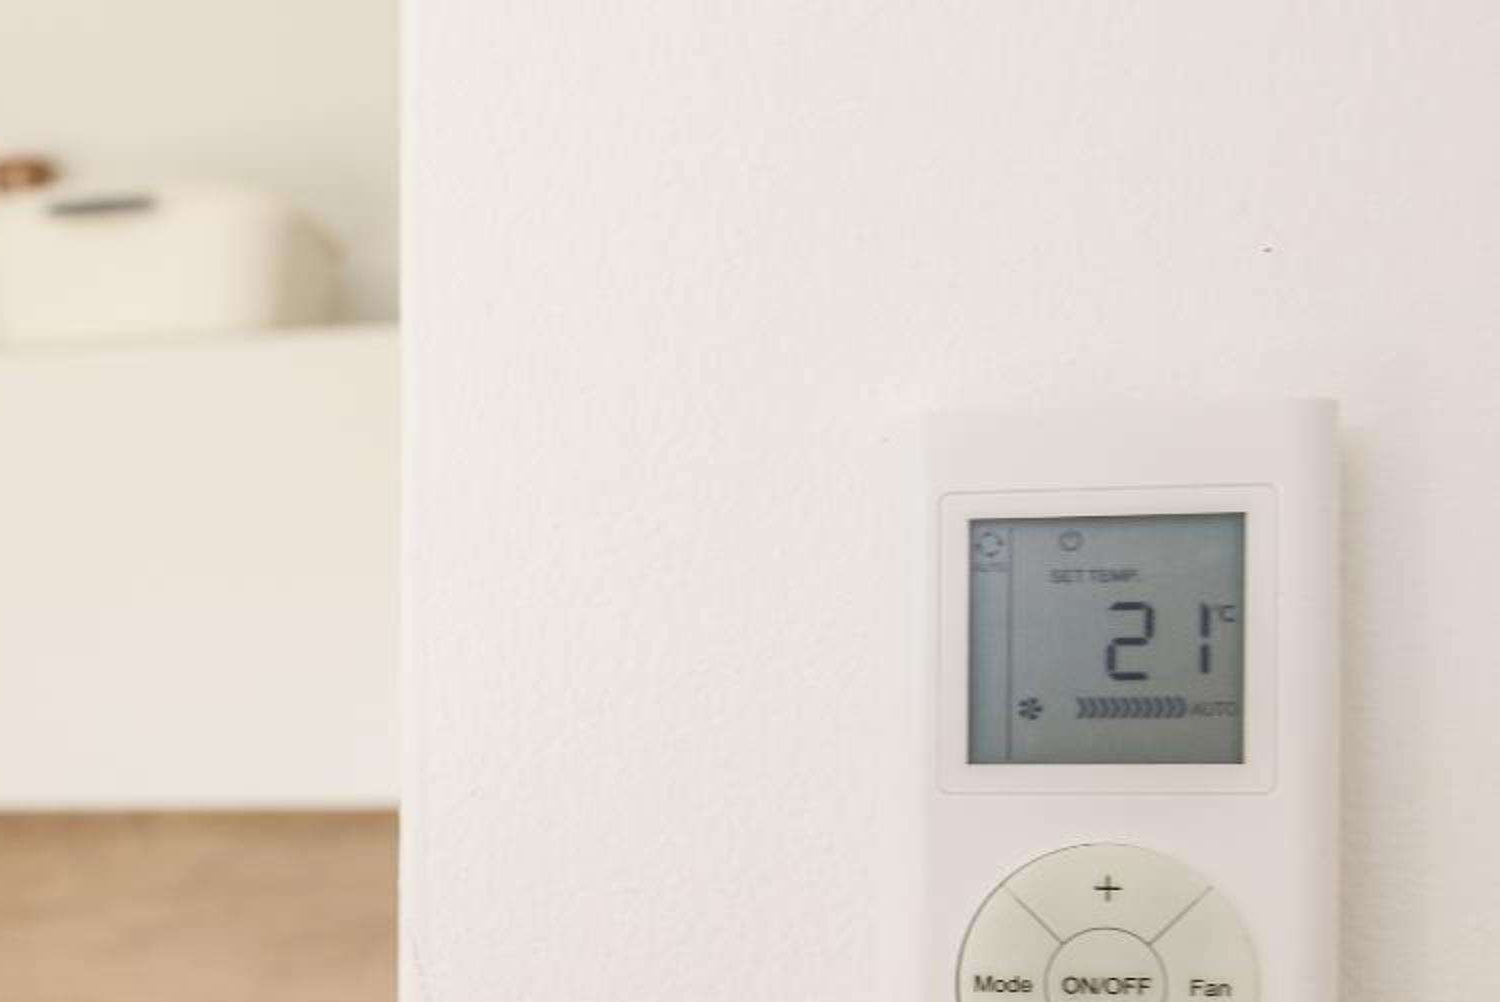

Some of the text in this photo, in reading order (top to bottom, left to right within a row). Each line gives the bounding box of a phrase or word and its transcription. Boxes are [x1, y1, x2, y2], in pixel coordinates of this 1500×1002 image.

[1050, 569, 1083, 583] SET
[1106, 601, 1211, 680] 21
[974, 975, 1033, 993] Mode
[1061, 977, 1152, 995] ON/OFF
[1188, 979, 1232, 997] Fan
